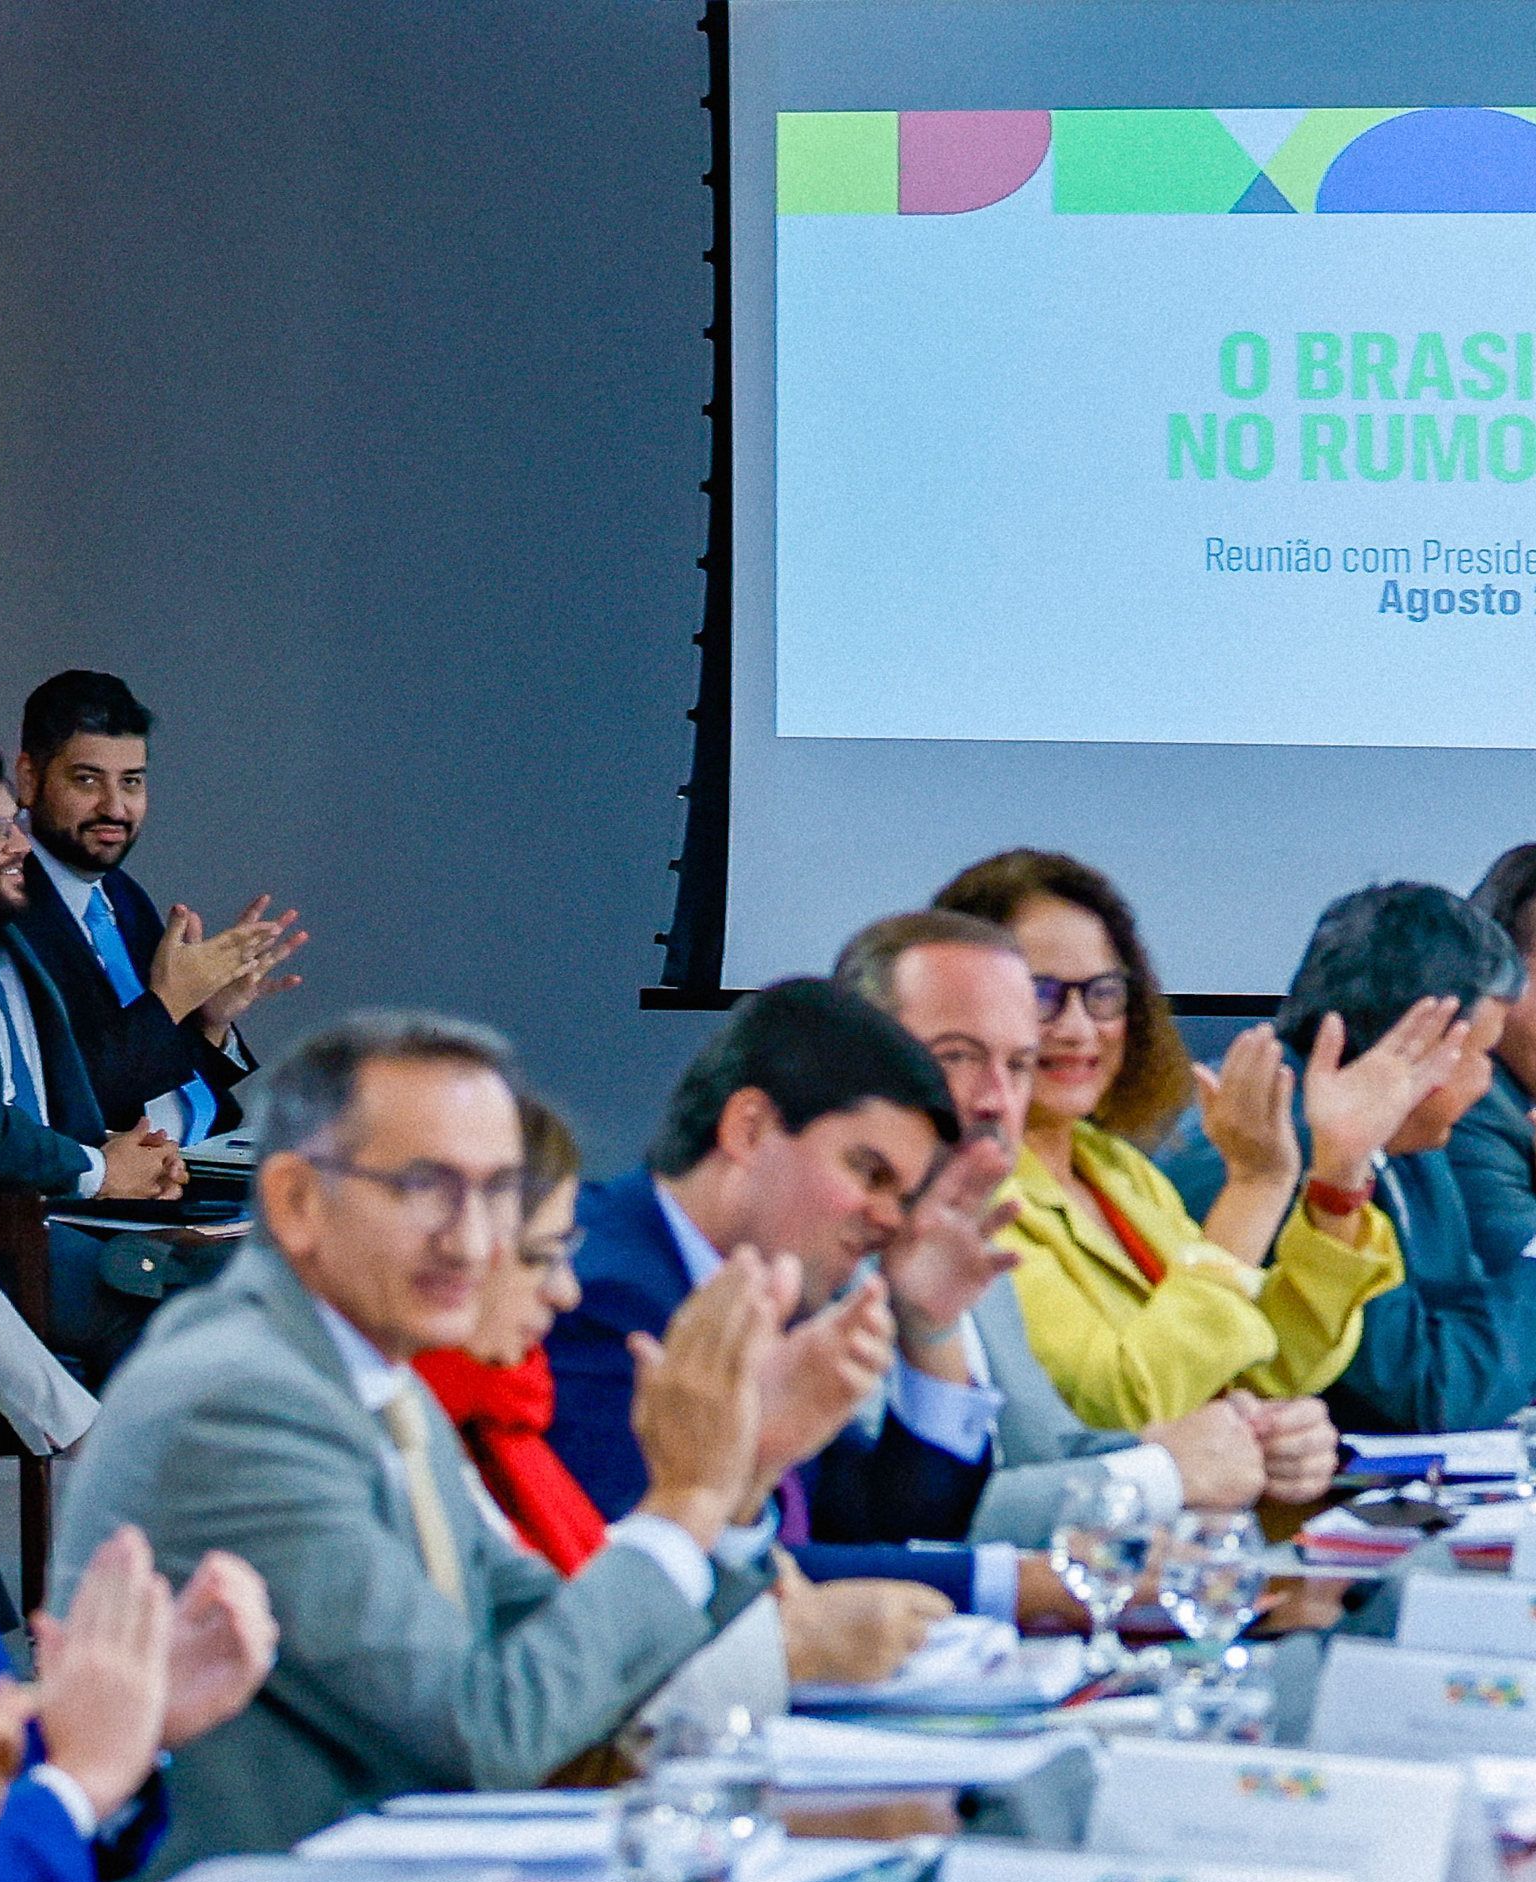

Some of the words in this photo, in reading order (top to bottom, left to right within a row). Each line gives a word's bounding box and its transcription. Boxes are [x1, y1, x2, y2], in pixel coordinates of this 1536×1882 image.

[1218, 330, 1271, 402] O
[1167, 411, 1277, 483] NO
[1205, 536, 1332, 575] Reunião
[1342, 546, 1412, 575] com
[1378, 579, 1522, 623] Agosto
